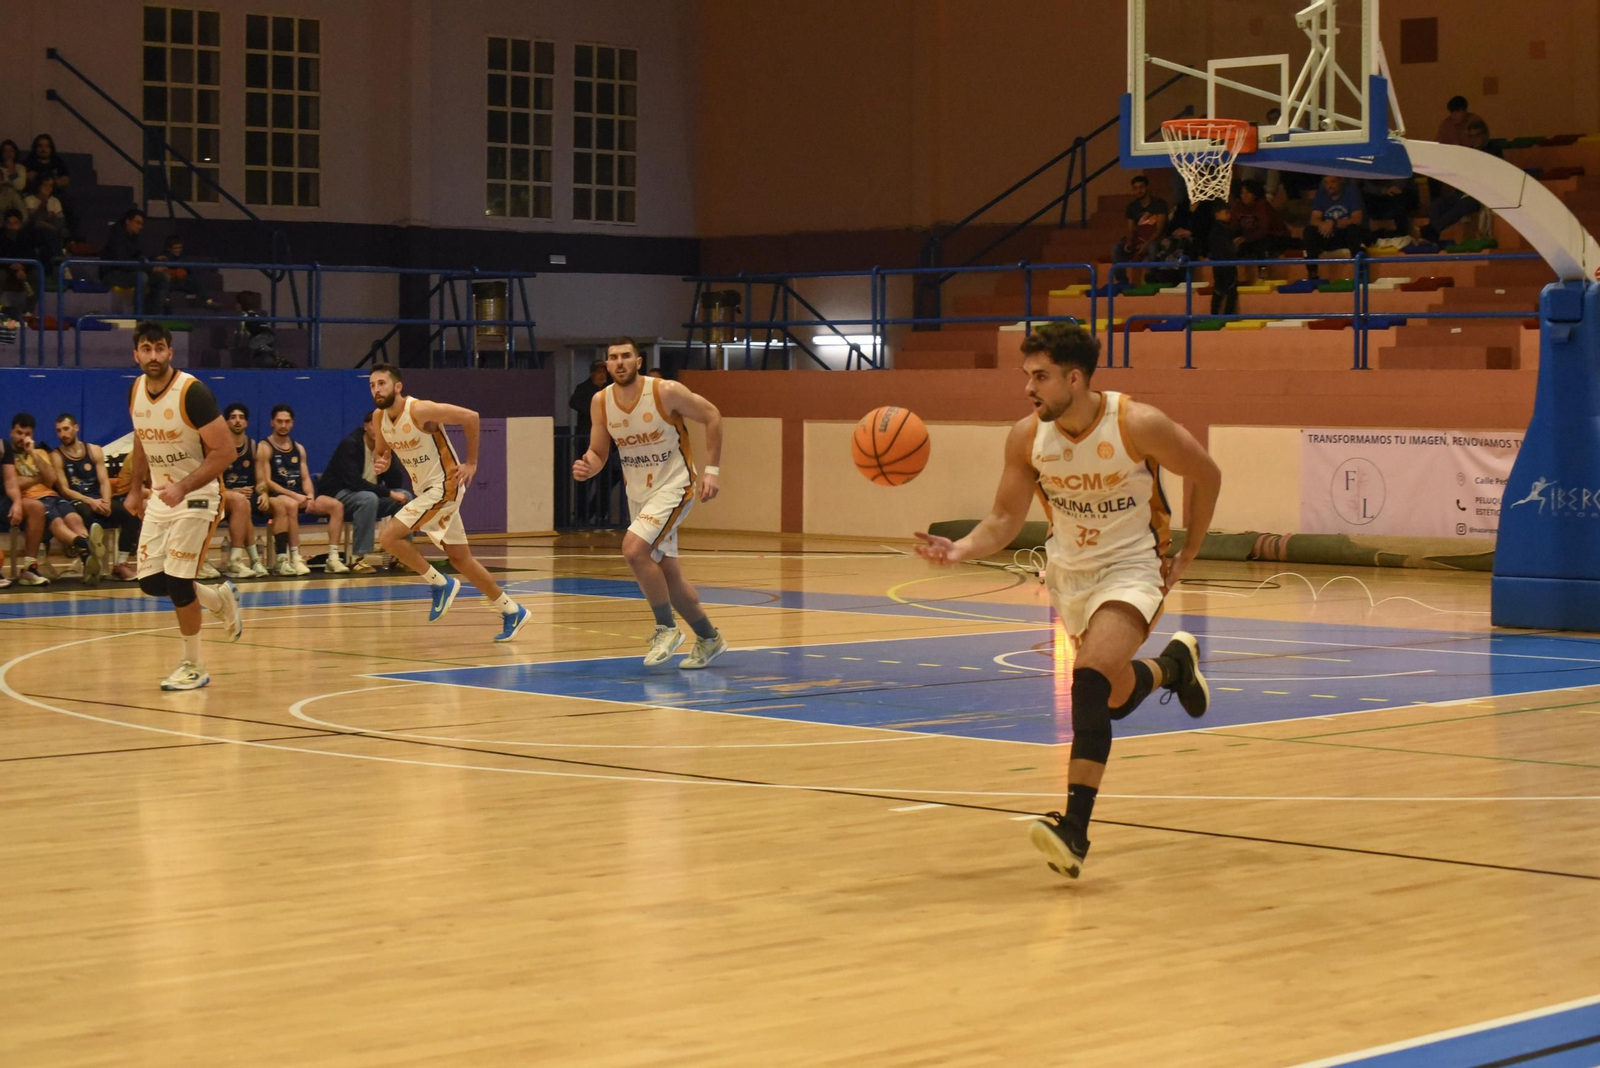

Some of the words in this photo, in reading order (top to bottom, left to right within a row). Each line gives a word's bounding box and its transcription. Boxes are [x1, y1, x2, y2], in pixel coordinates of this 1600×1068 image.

[1308, 434, 1392, 444] TRANSFORMAMOS
[1394, 435, 1407, 445] TU
[1409, 435, 1450, 446] IMAGEN,
[1452, 436, 1512, 448] RENOVAMOS
[1345, 470, 1357, 491] F
[1475, 476, 1494, 485] Calle
[1098, 496, 1136, 513] OLEA
[1363, 498, 1374, 519] L
[1075, 524, 1101, 548] 32
